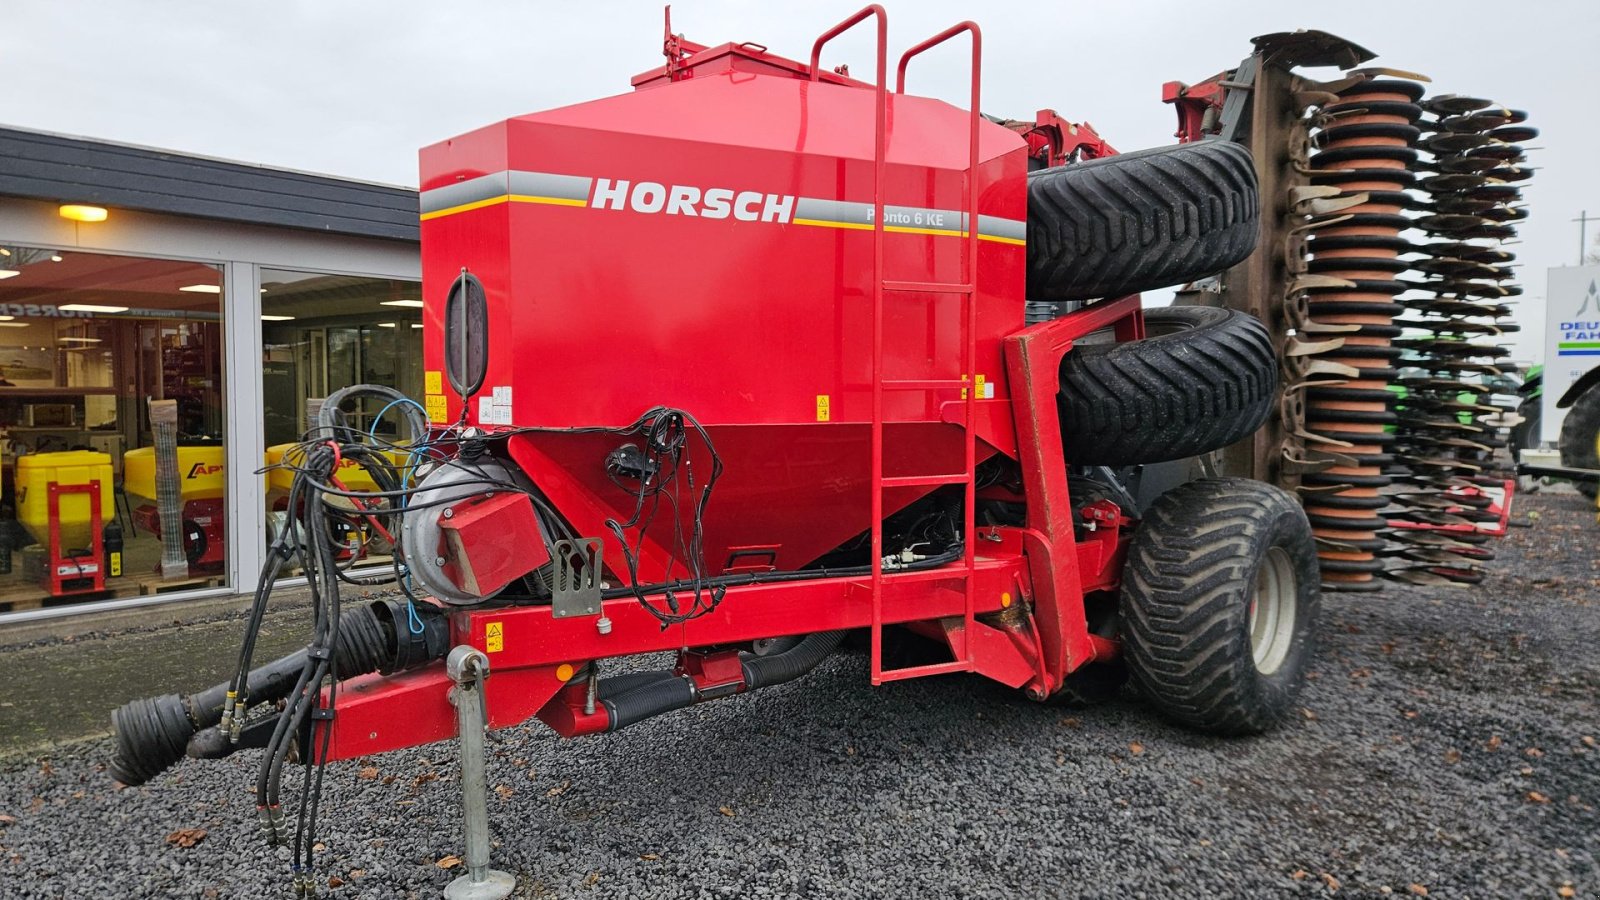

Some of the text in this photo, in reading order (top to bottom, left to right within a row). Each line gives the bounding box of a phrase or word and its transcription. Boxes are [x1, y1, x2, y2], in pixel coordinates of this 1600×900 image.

[591, 178, 794, 224] HORSCH
[866, 208, 944, 226] Ponto 6 KE
